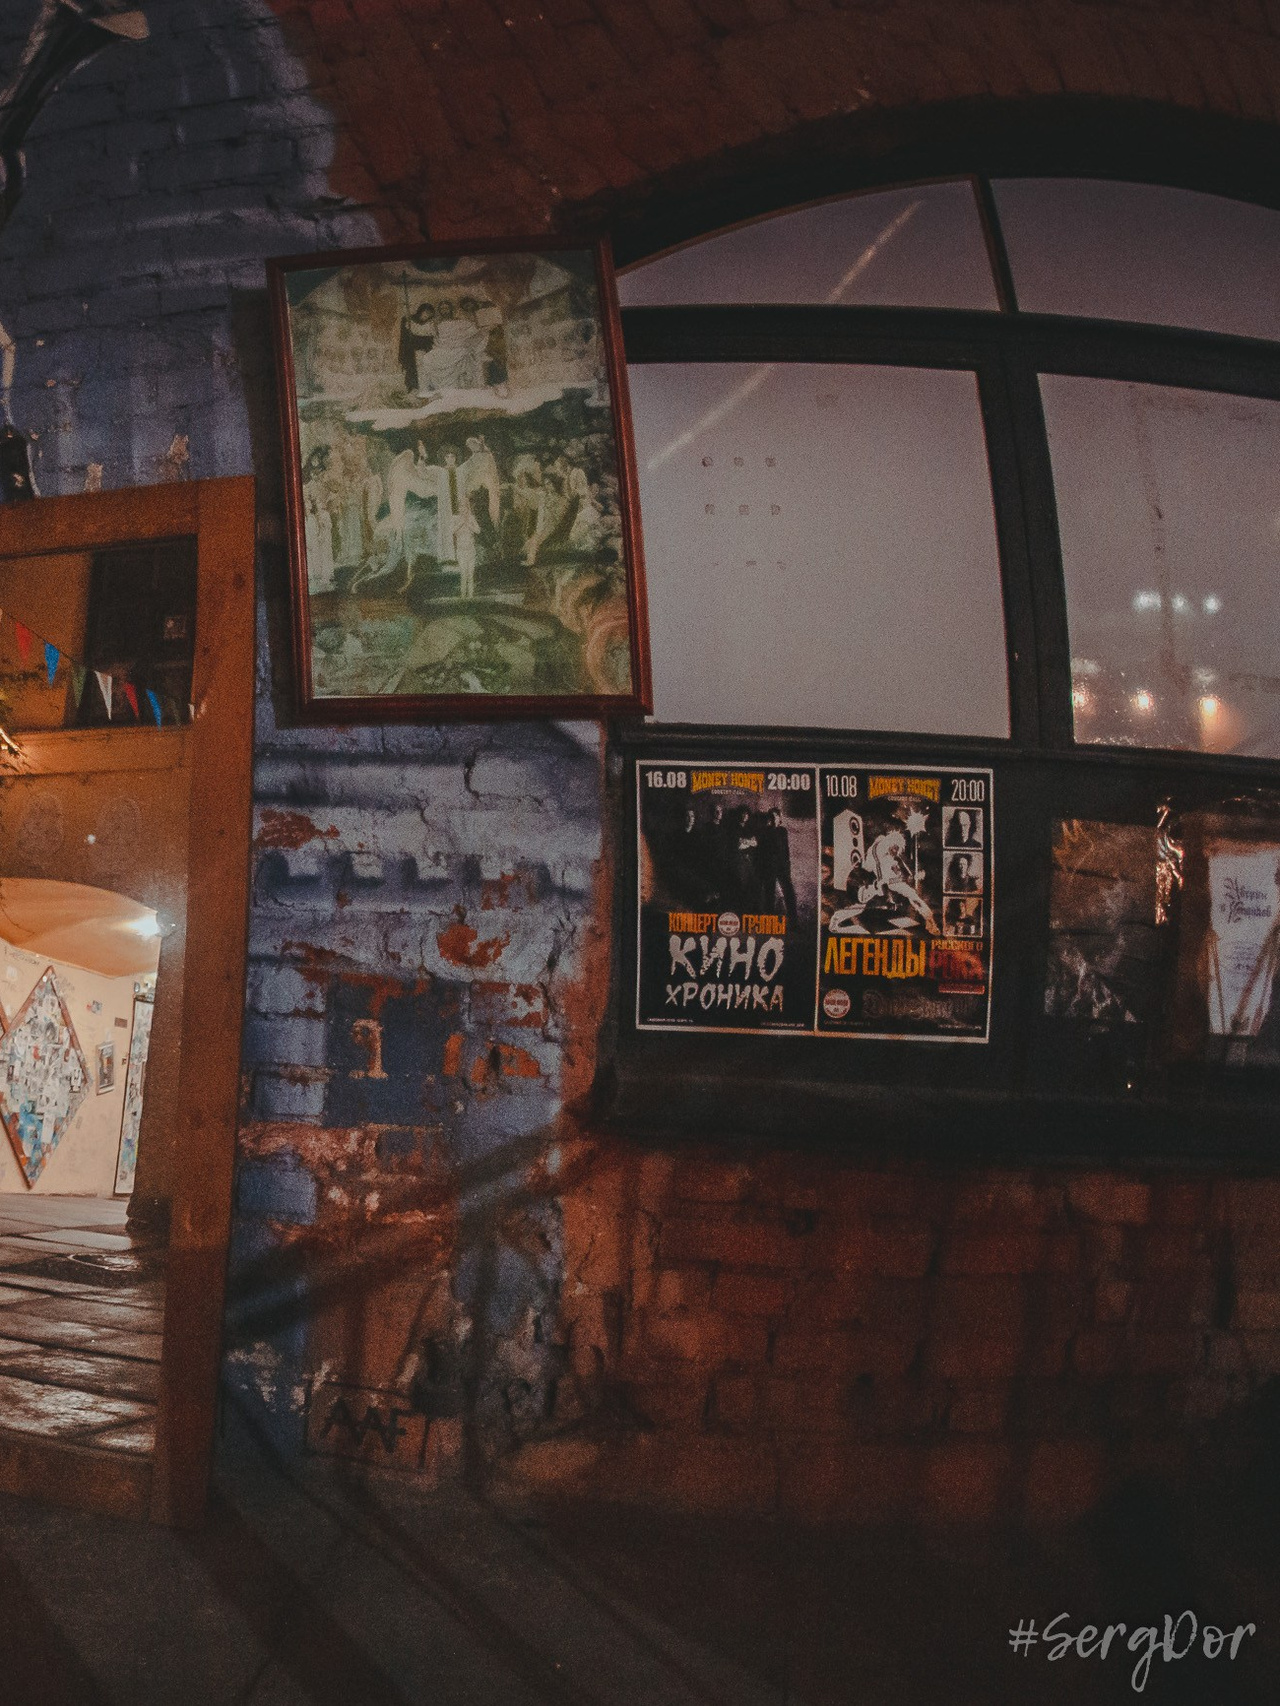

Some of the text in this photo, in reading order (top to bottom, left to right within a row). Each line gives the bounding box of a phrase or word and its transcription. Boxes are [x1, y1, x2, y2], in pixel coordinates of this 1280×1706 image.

[645, 771, 687, 788] 16.08
[691, 771, 765, 795] MONEY HONEY
[767, 773, 811, 791] 20:00
[825, 775, 857, 797] 10.08
[951, 779, 985, 802] 20:00
[668, 912, 718, 934] КОНЦЕРТ
[742, 914, 787, 934] ГРУППЫ
[669, 934, 785, 982] КИНО
[824, 936, 927, 980] ЛЕГЕНДЫ
[665, 982, 784, 1013] ХРОНИКА
